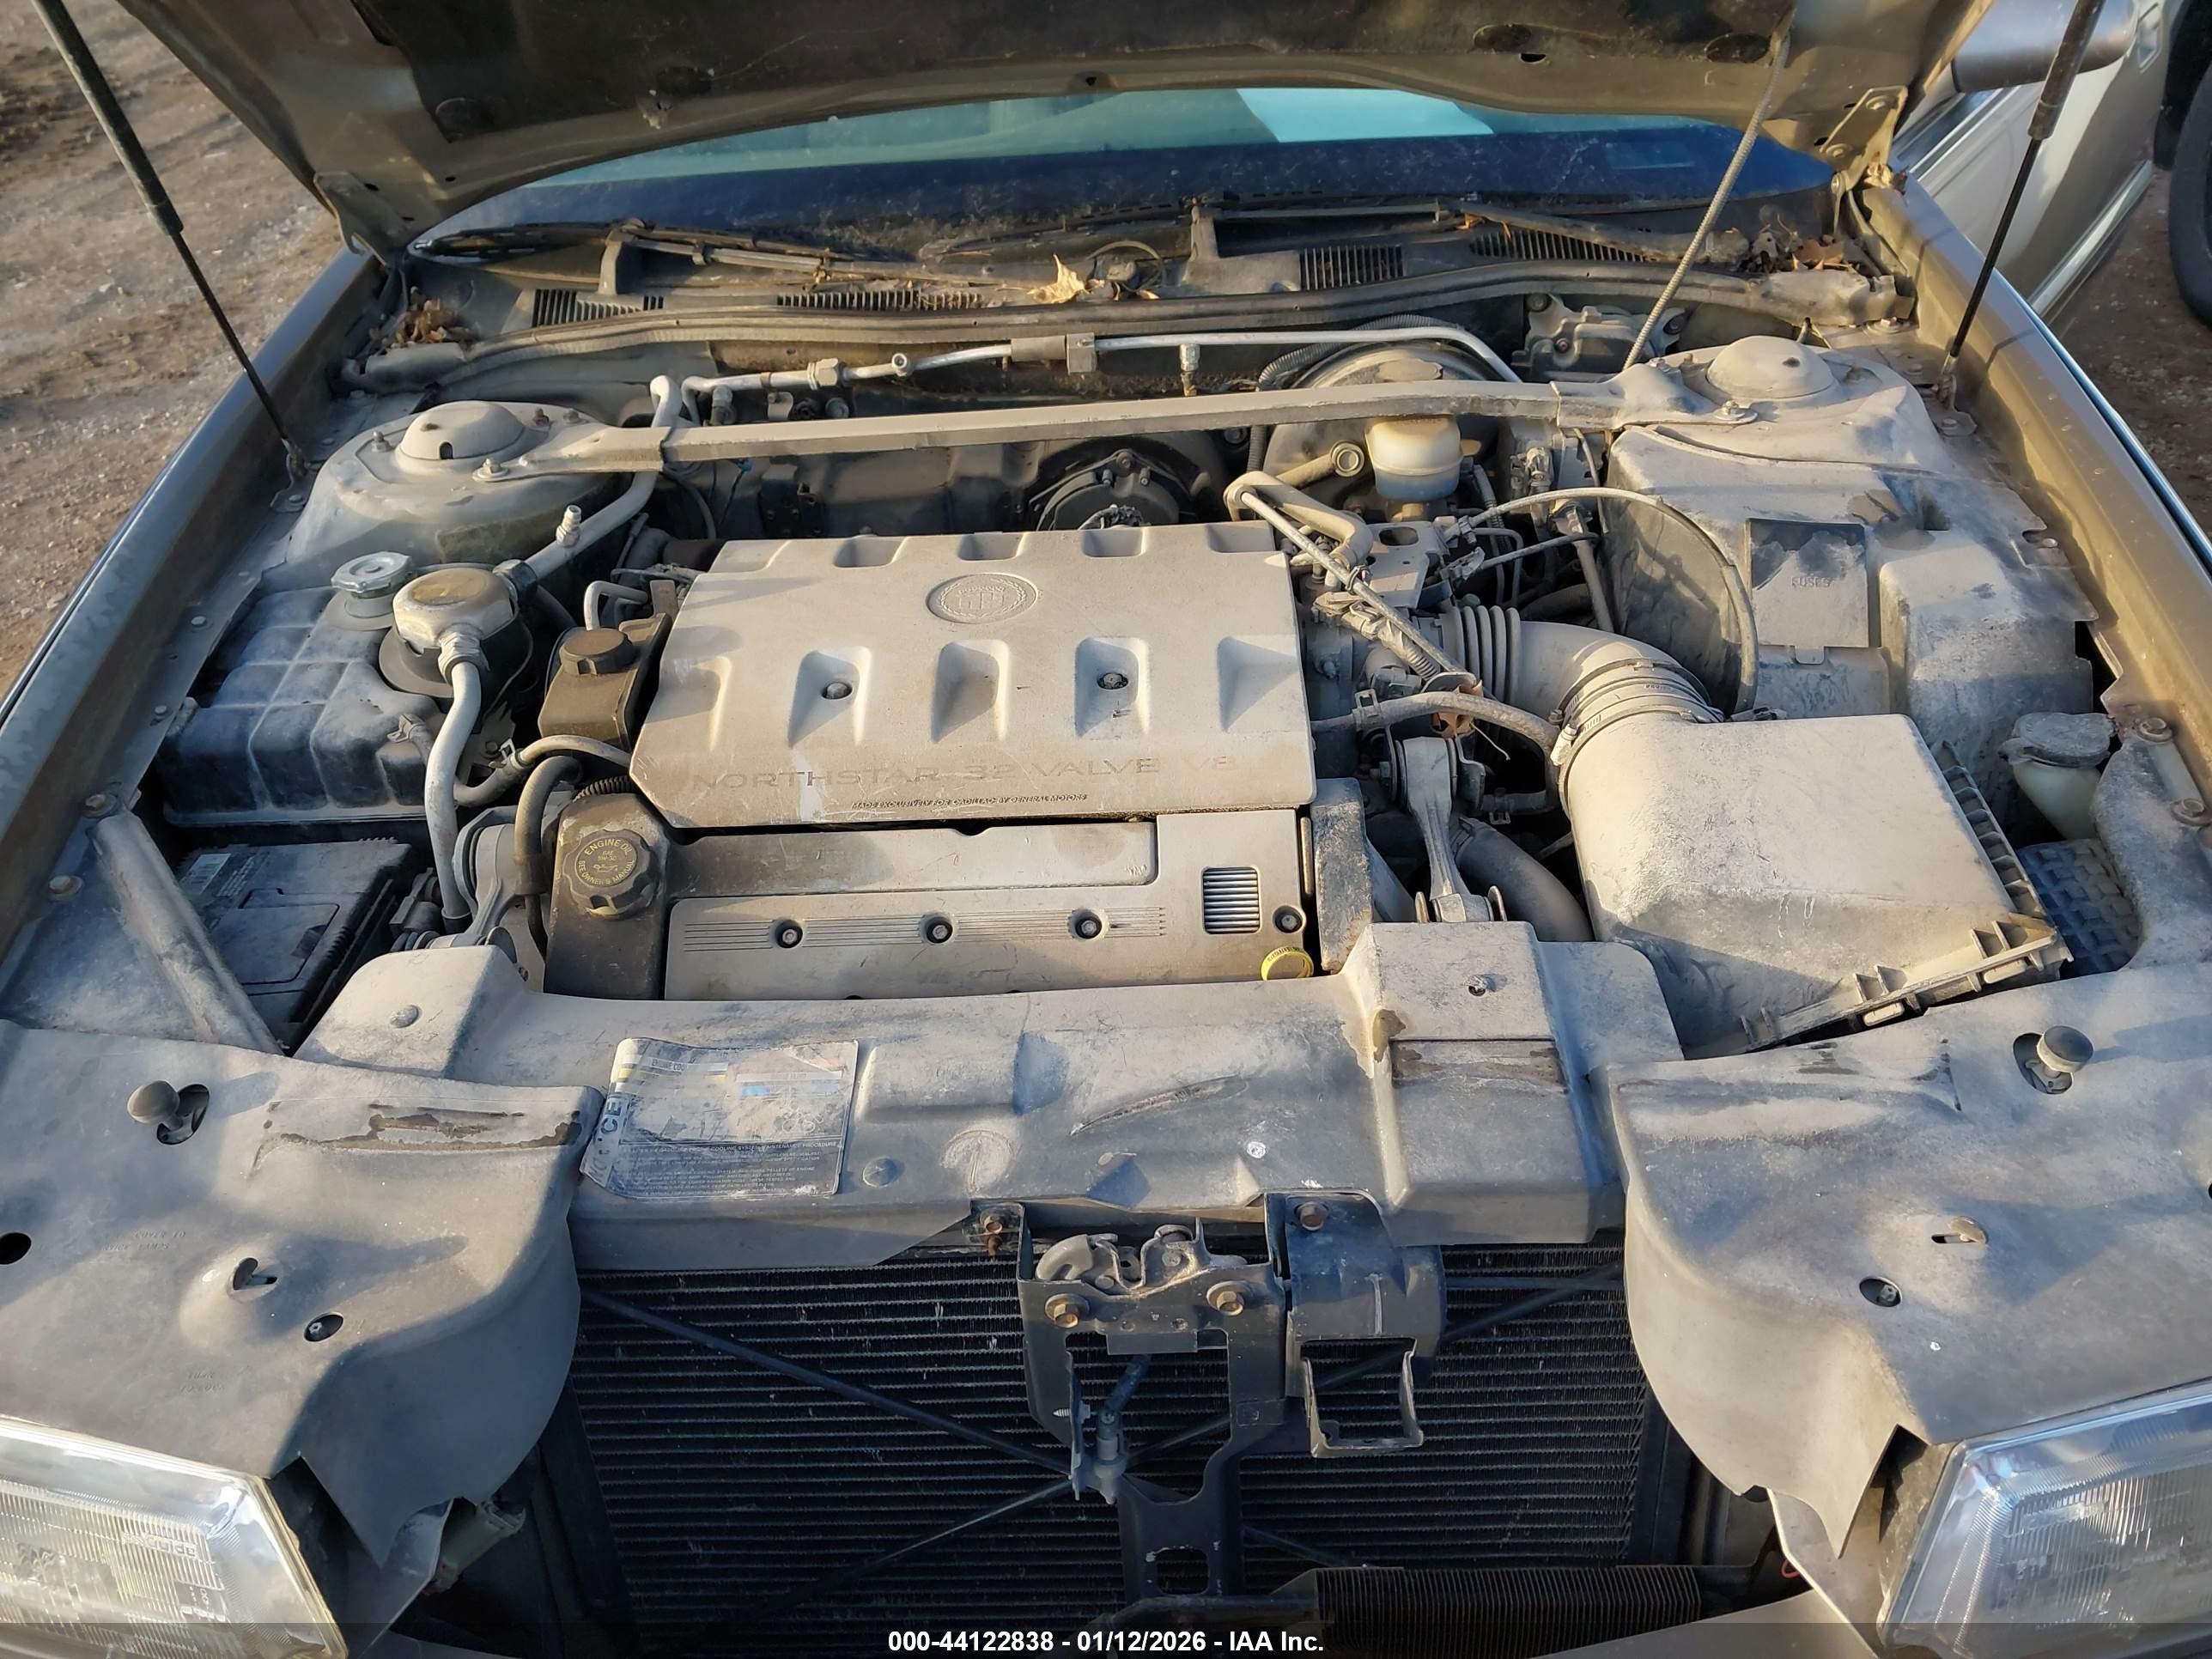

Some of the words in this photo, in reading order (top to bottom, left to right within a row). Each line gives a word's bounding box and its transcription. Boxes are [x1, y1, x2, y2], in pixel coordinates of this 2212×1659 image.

[692, 767, 942, 791] NORTHSTAR
[1030, 757, 1160, 779] VALVE
[584, 838, 622, 855] ENGINE
[620, 842, 634, 855] OIL
[578, 860, 586, 874] SEE
[611, 859, 635, 883] MANUAL
